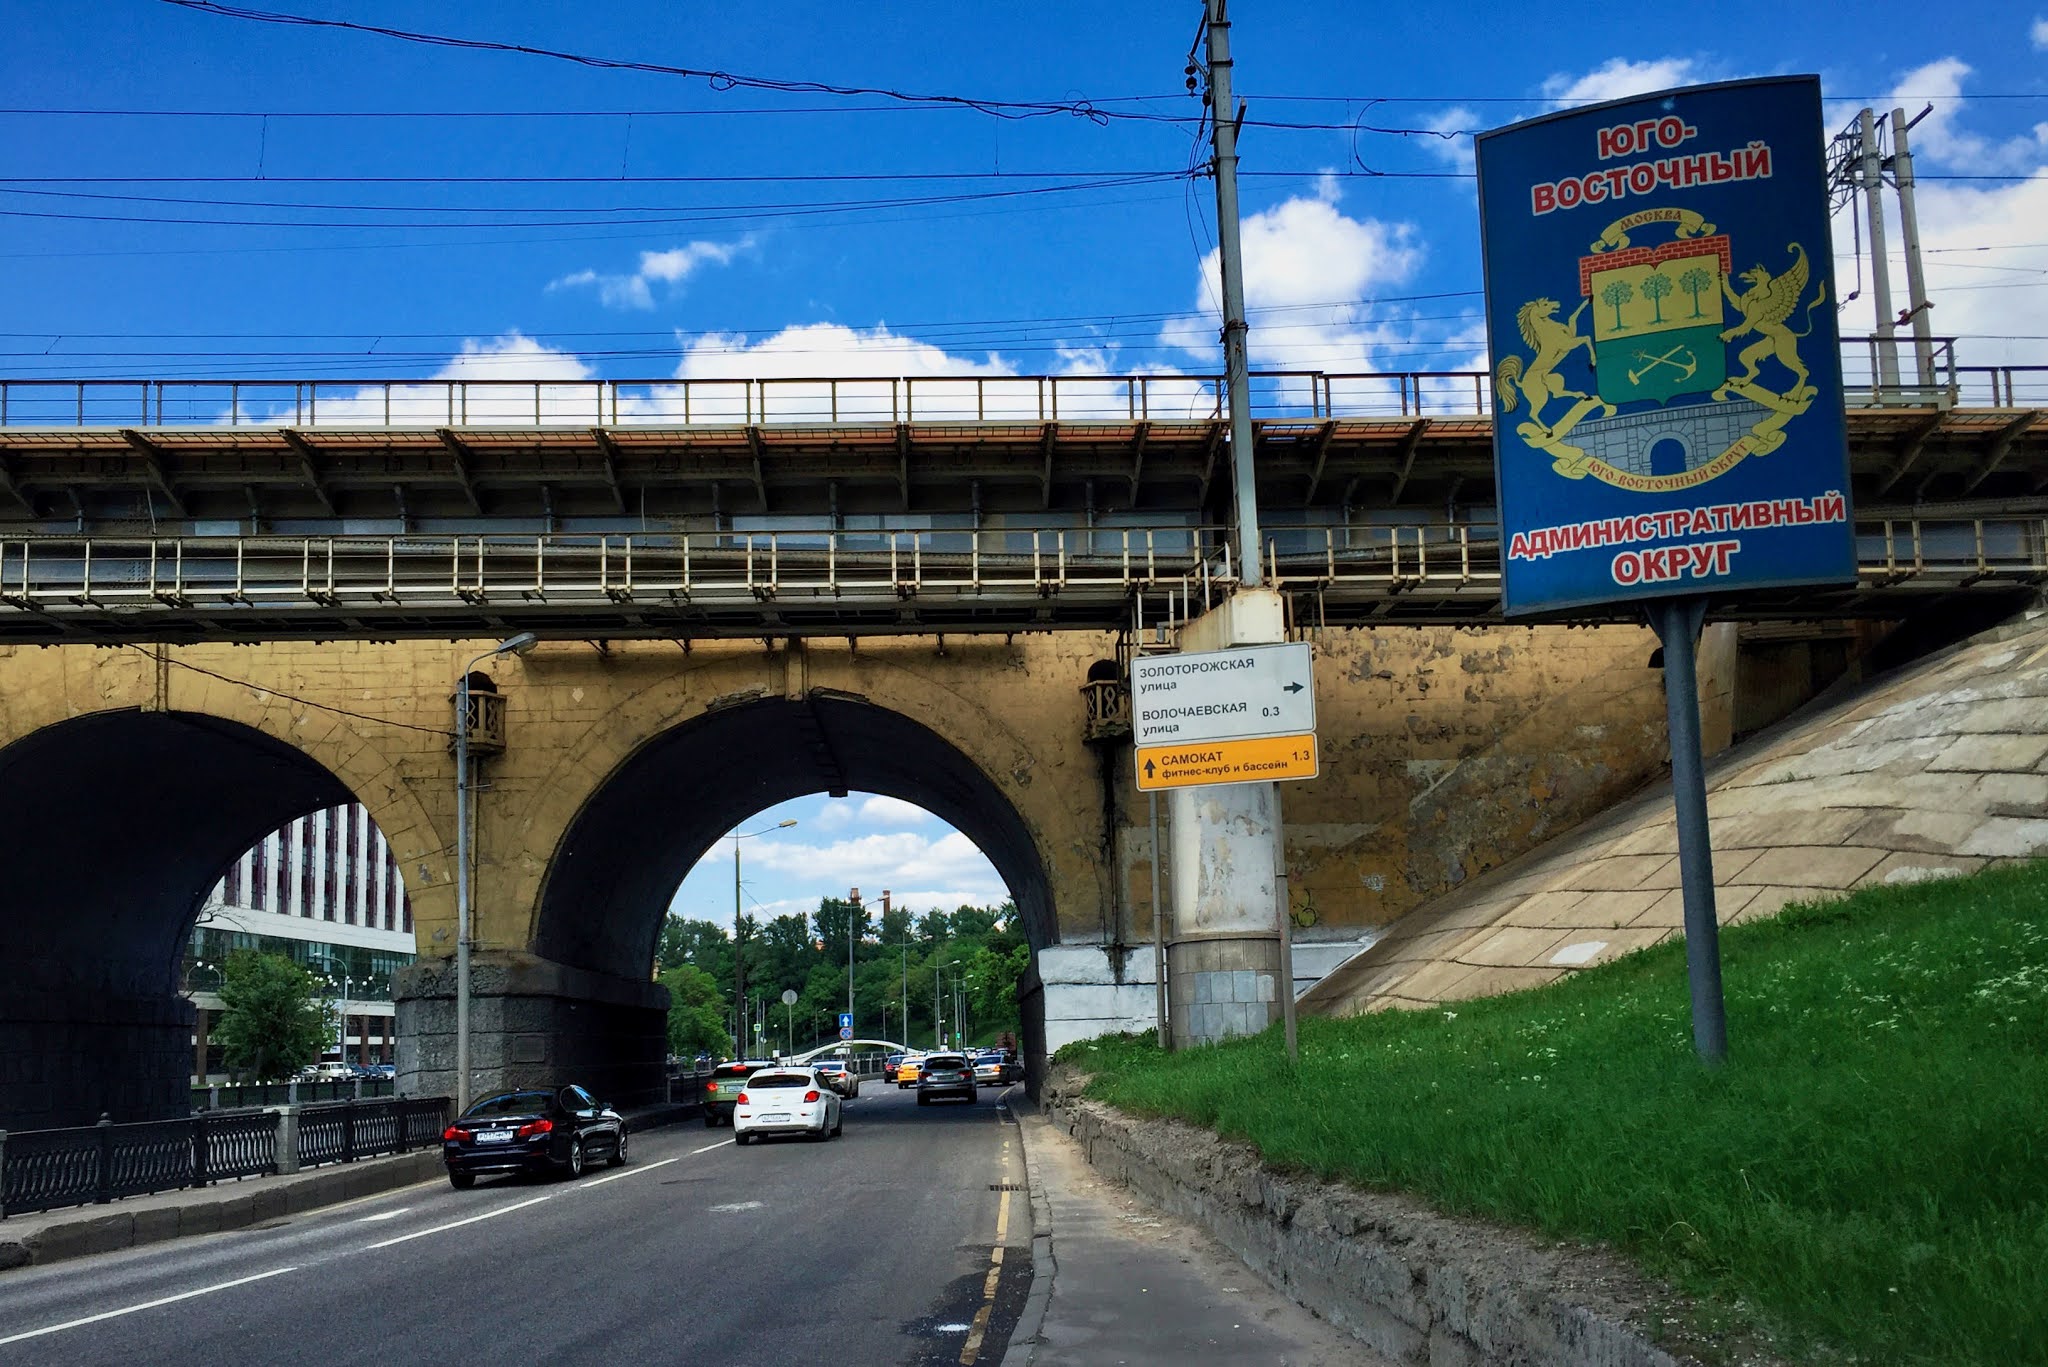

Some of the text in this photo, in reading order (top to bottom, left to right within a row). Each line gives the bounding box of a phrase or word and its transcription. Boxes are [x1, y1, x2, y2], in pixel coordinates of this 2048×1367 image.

[1597, 115, 1697, 160] ЮГО-
[1531, 140, 1772, 215] ВОСТОЧНЫЙ
[1620, 209, 1682, 231] МОСКВА
[1587, 440, 1748, 490] ЮГО-ВОСТОЧНЫЙ ОКРУГ
[1508, 490, 1846, 560] АДМИНИСТРАТИВНЫЙ
[1612, 540, 1740, 586] ОКРУГ
[1139, 658, 1255, 678] ЗОЛОТОРОЖСКАЯ
[1140, 681, 1177, 694] улица
[1142, 702, 1280, 721] ВОЛОЧАЕВСКАЯ 0.3
[1142, 723, 1179, 736] улица
[1161, 750, 1310, 766] САМОКАТ 1.3
[1161, 760, 1288, 780] фитнес-клуб и бассейн
